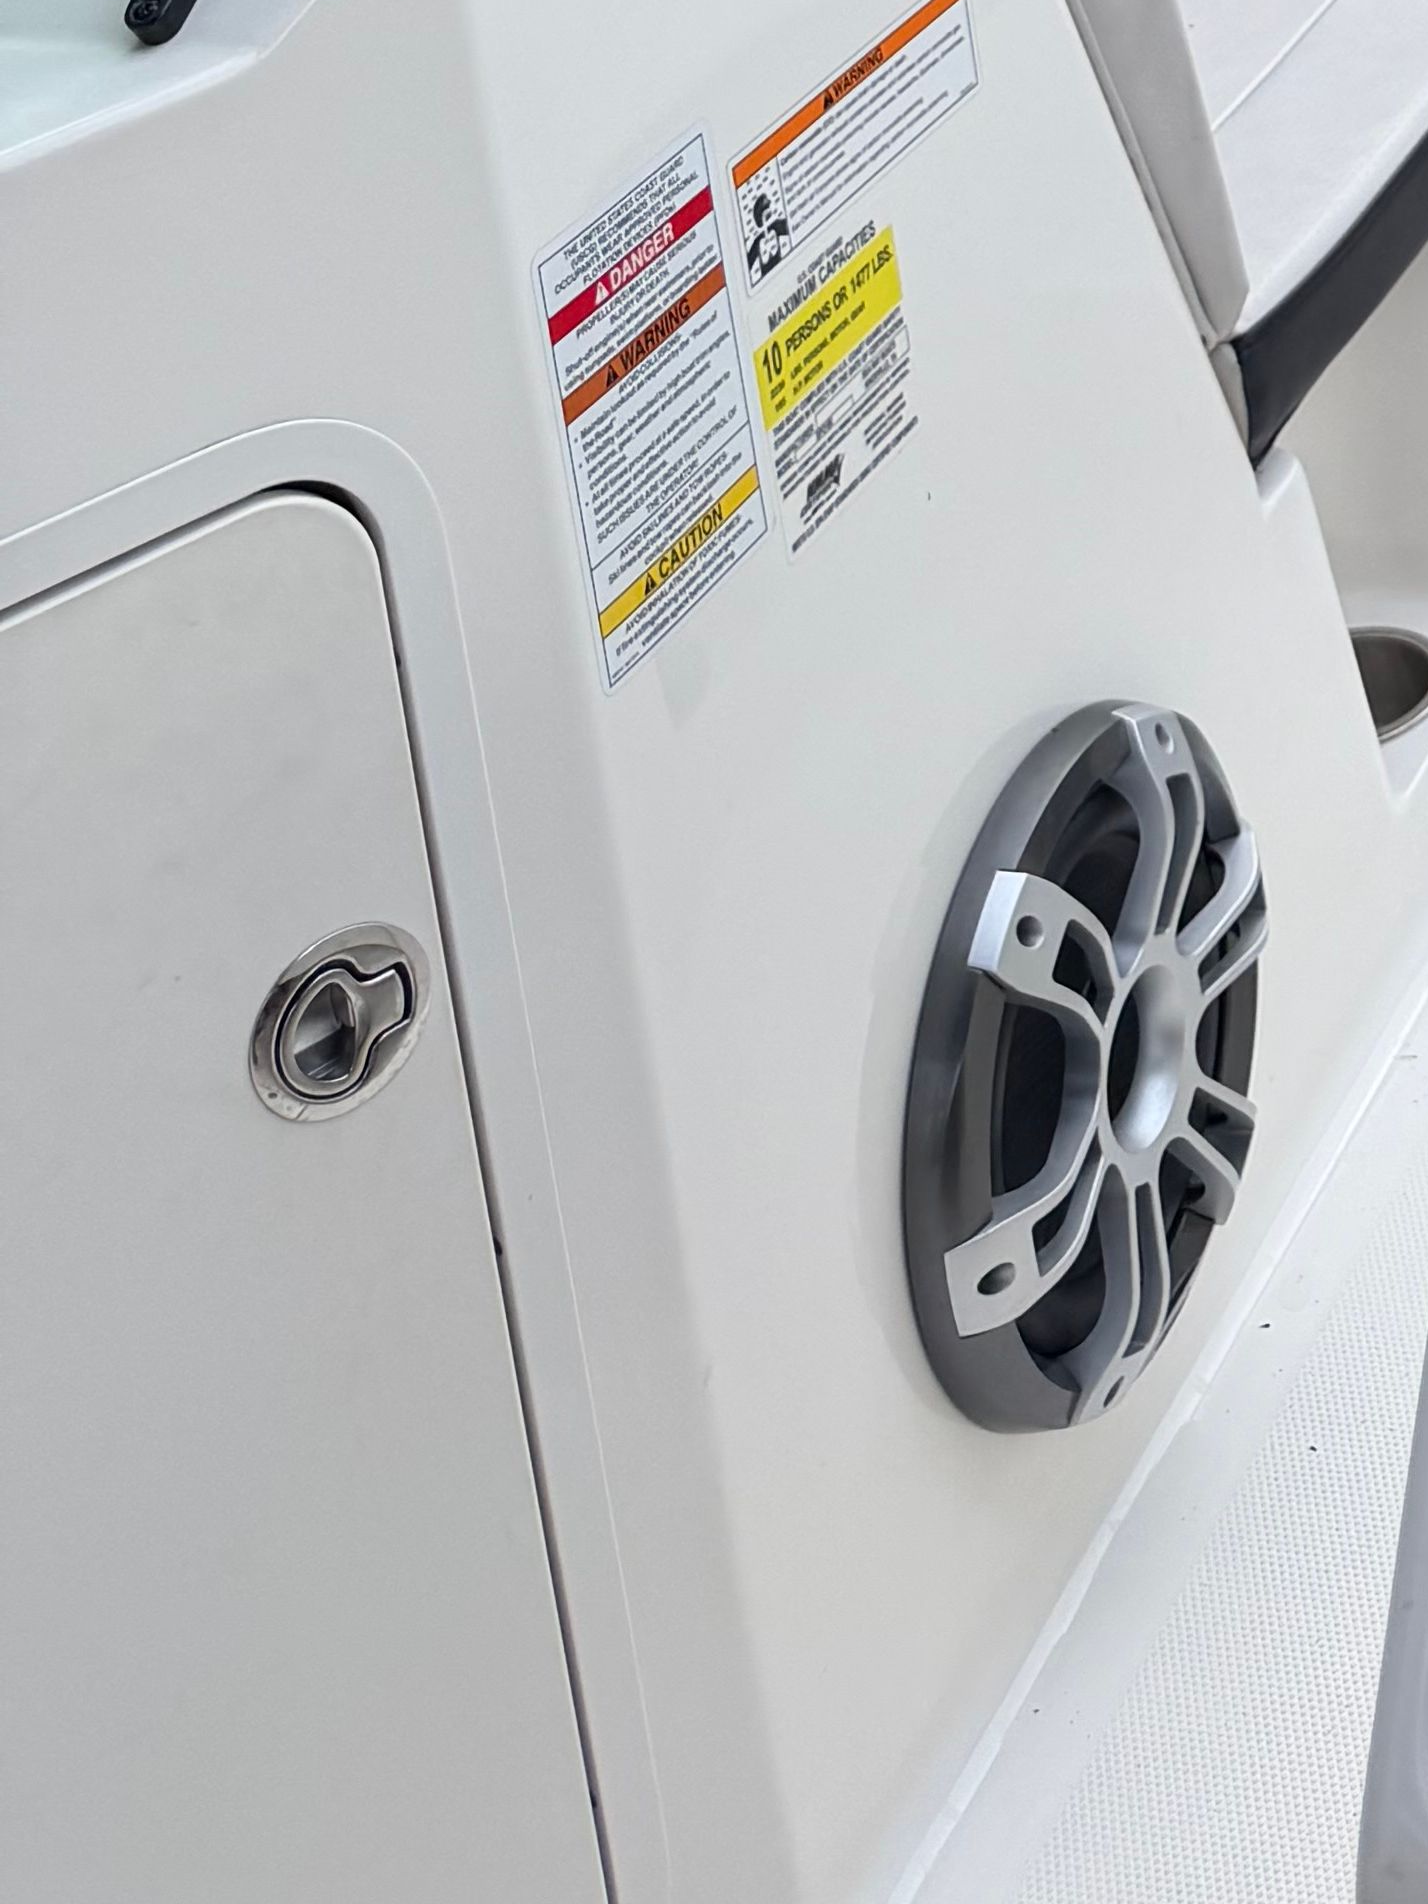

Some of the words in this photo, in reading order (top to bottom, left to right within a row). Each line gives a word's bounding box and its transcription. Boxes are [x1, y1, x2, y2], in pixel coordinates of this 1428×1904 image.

[832, 47, 884, 100] WARNING
[610, 222, 674, 289] DANGER
[768, 276, 817, 332] MAXIMUM
[818, 220, 876, 285] CAPACITIES
[621, 297, 690, 372] WARNING
[762, 341, 782, 383] 10
[785, 301, 832, 356] PERSONS
[833, 286, 849, 310] OR
[658, 503, 722, 580] CAUTION
